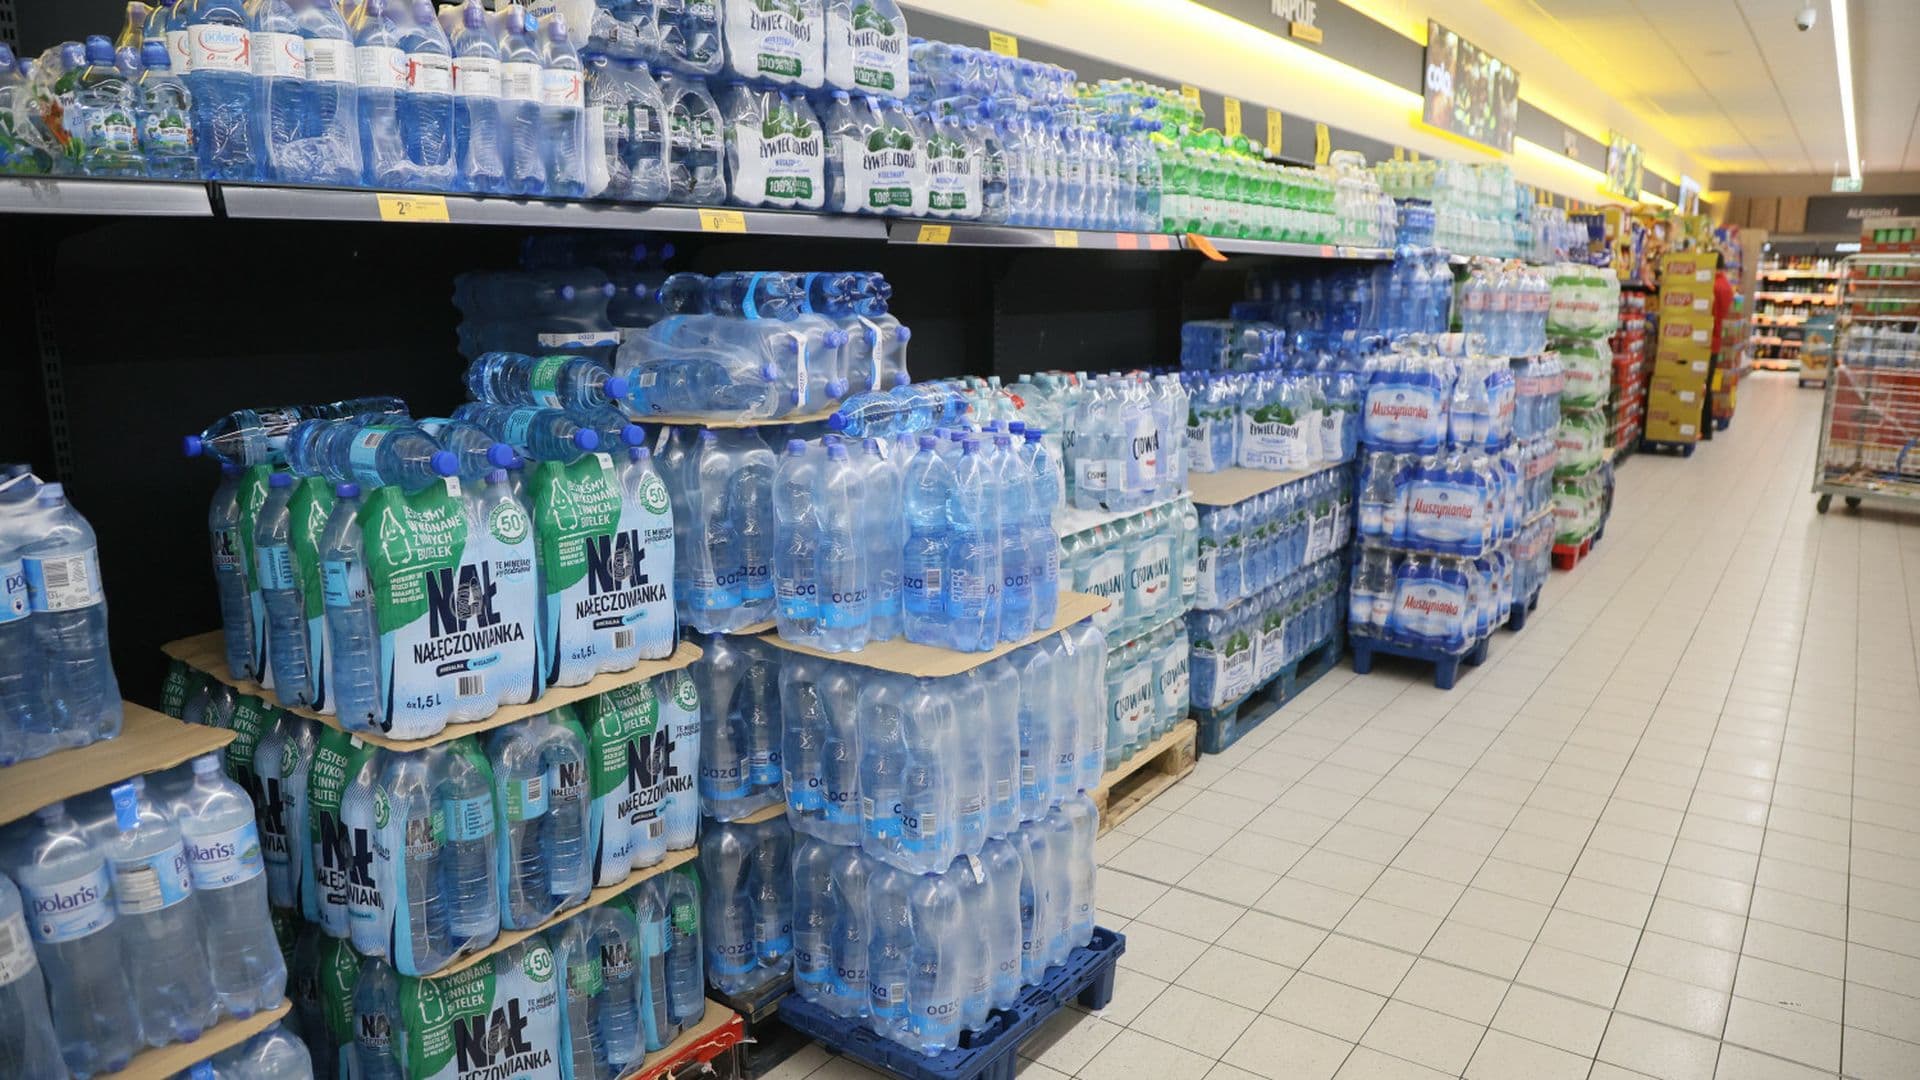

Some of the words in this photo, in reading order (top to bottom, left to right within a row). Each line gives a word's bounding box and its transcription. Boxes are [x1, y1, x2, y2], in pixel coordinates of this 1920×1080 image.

[1413, 497, 1473, 519] Muszynianka
[1403, 594, 1460, 616] Muszynianka
[414, 622, 525, 664] NAŁĘCZOWIANKA
[34, 885, 96, 916] polaris
